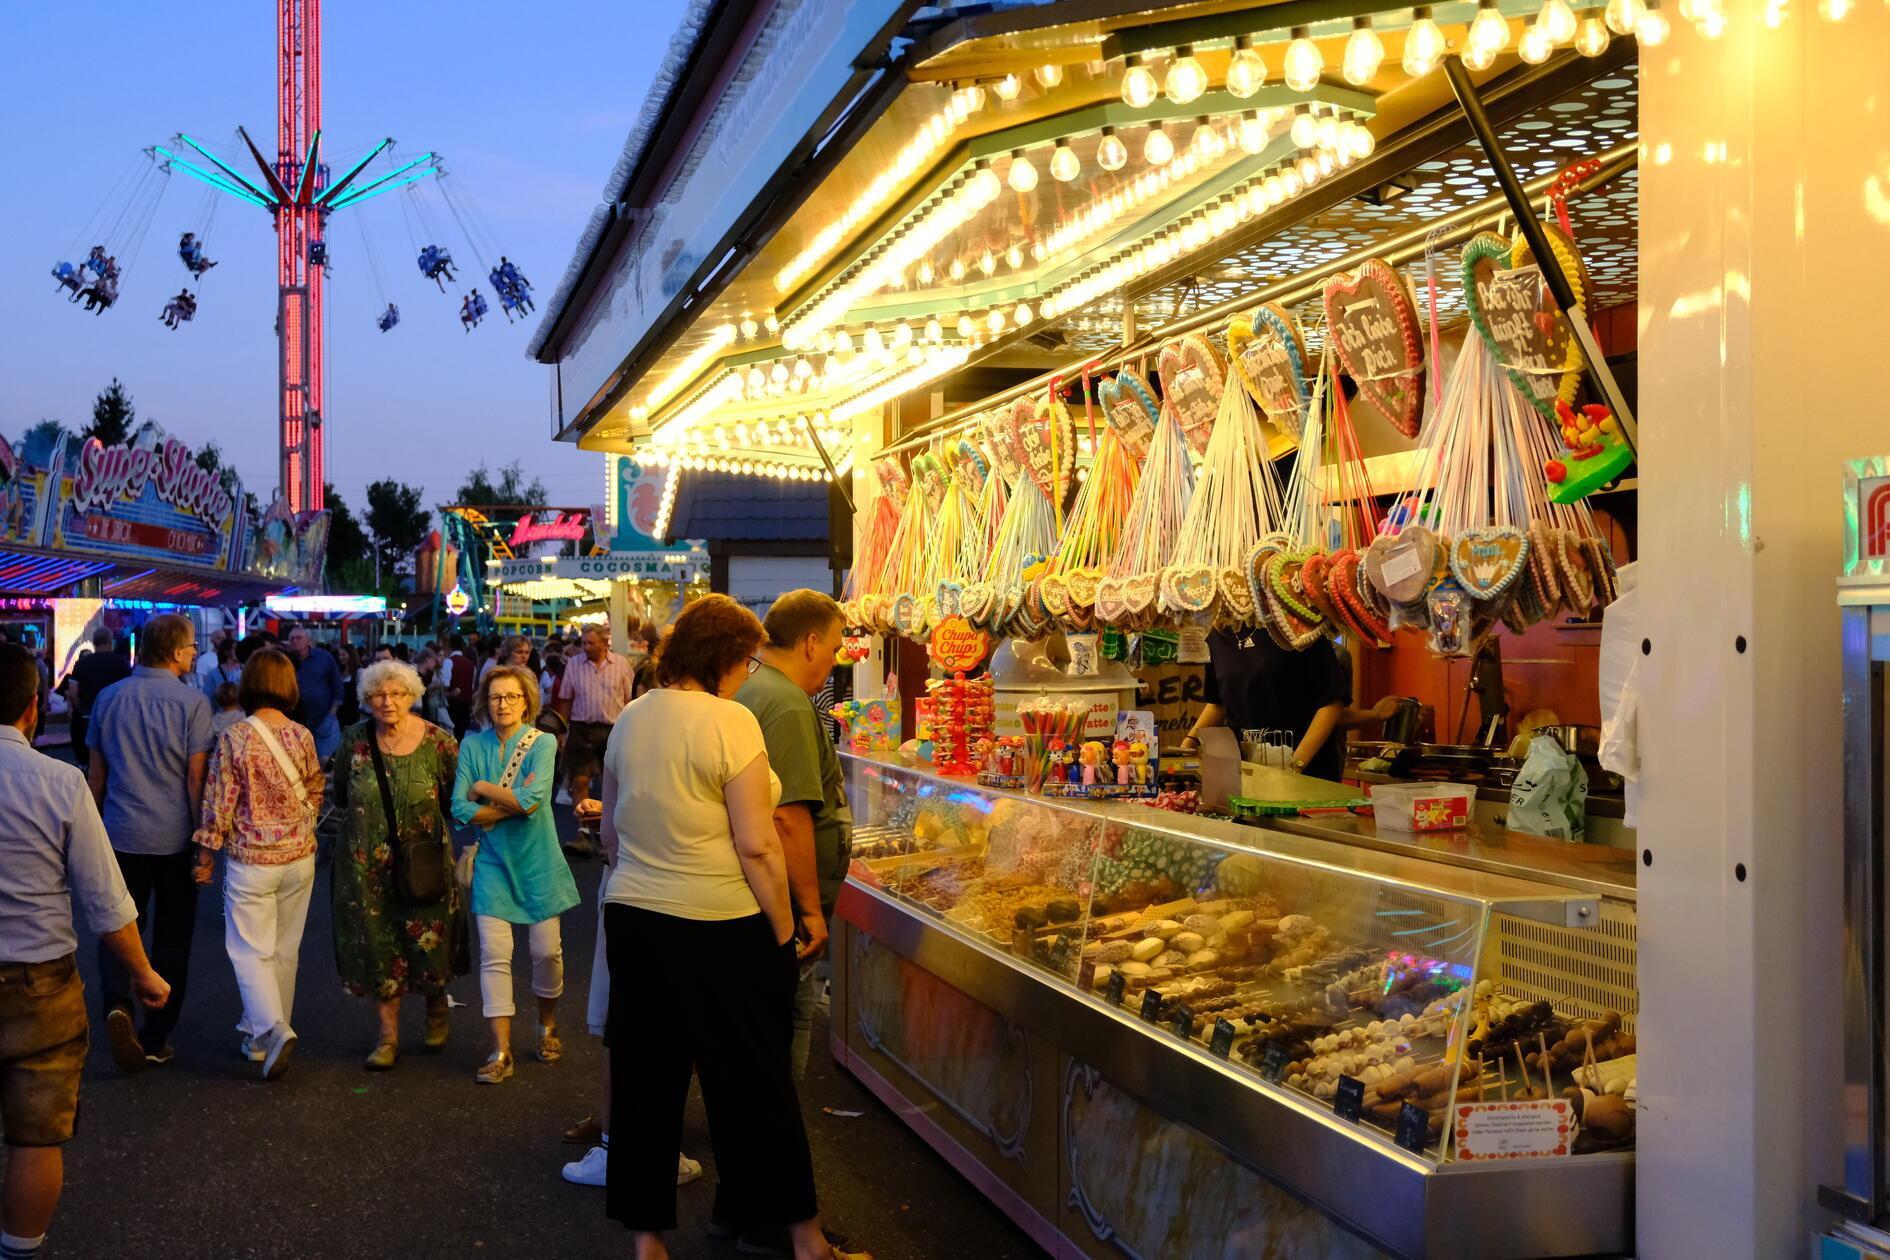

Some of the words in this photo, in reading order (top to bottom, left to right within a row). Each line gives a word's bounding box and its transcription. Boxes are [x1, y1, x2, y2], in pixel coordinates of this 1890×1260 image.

[494, 562, 553, 577] POPCORN
[942, 629, 978, 644] Chupa
[940, 640, 978, 656] Chups
[1135, 673, 1207, 707] LER
